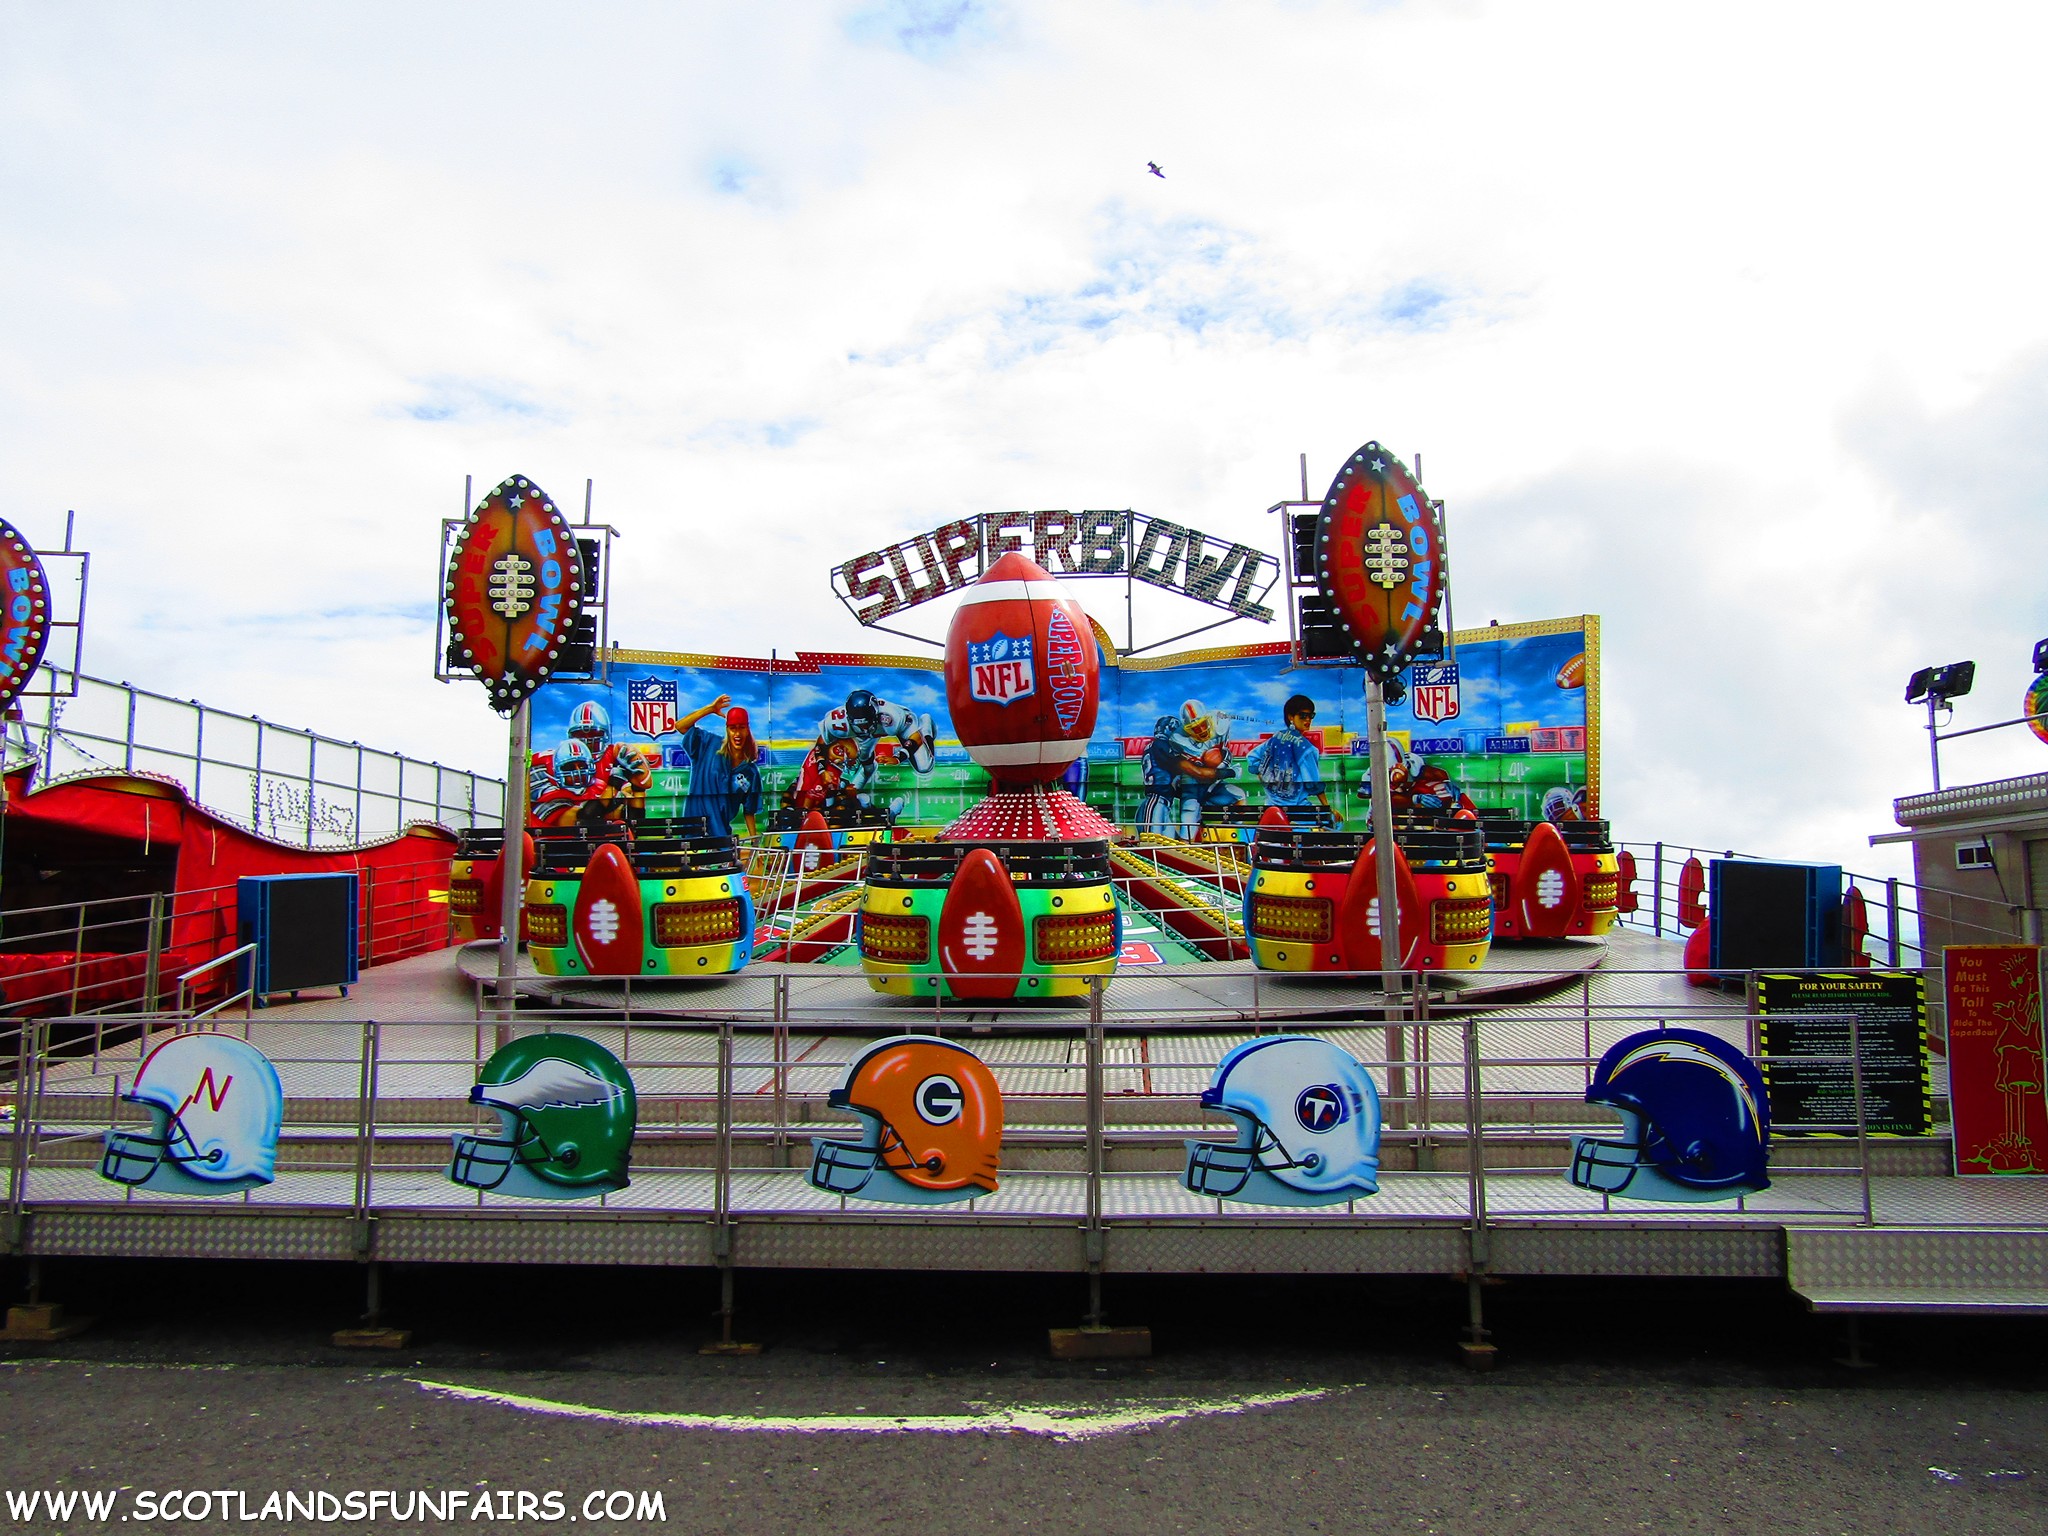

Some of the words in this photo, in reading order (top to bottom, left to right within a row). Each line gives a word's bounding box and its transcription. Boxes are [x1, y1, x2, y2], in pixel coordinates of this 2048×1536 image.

[1341, 484, 1379, 628] SUPER
[1397, 494, 1431, 621] BOWL
[461, 523, 499, 663] SUPER
[523, 528, 562, 651] BOWL
[975, 662, 1029, 698] NFL
[632, 702, 675, 735] NFL
[1416, 686, 1457, 719] NFL
[1435, 739, 1461, 751] 2001
[1956, 971, 1987, 981] Must
[1960, 957, 1982, 967] You
[1799, 982, 1818, 990] FOR
[1820, 982, 1847, 990] YOUR
[1848, 982, 1883, 990] SAFETY
[1961, 997, 1984, 1007] Tall
[1971, 984, 1990, 992] This
[1954, 1019, 1973, 1027] Ride
[1978, 1019, 1992, 1027] The
[193, 1066, 234, 1112] N
[916, 1075, 962, 1124] G
